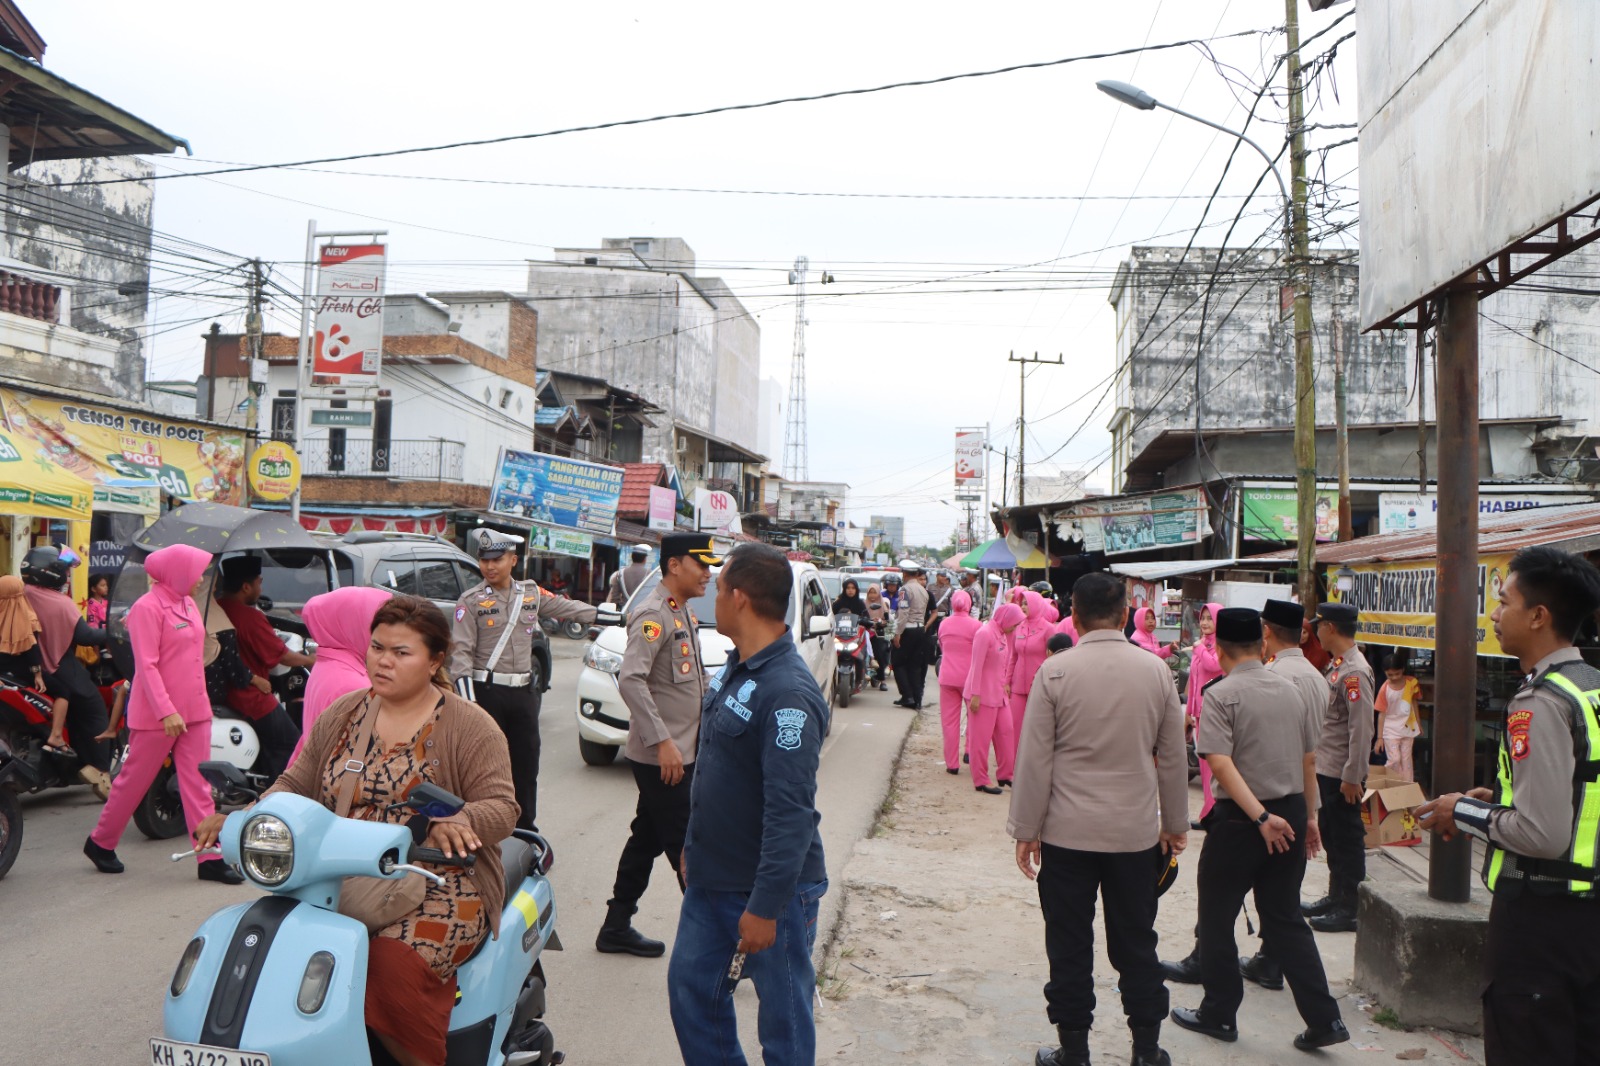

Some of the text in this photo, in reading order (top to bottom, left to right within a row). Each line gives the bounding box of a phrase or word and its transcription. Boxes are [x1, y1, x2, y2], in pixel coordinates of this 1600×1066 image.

[325, 248, 349, 256] NEW
[317, 296, 354, 315] Fresh
[62, 406, 205, 442] TENDA TEH POCI
[123, 451, 161, 467] POCI
[260, 462, 290, 476] Es Teh
[549, 461, 600, 479] PANGKALAN
[601, 470, 623, 483] OJEK
[547, 472, 573, 485] SABAR
[574, 477, 608, 492] MENANTI
[609, 484, 620, 494] 03
[88, 555, 125, 567] NGAN
[1379, 569, 1418, 612] MAKAN
[24, 694, 53, 713] VAR
[152, 1043, 175, 1066] KH
